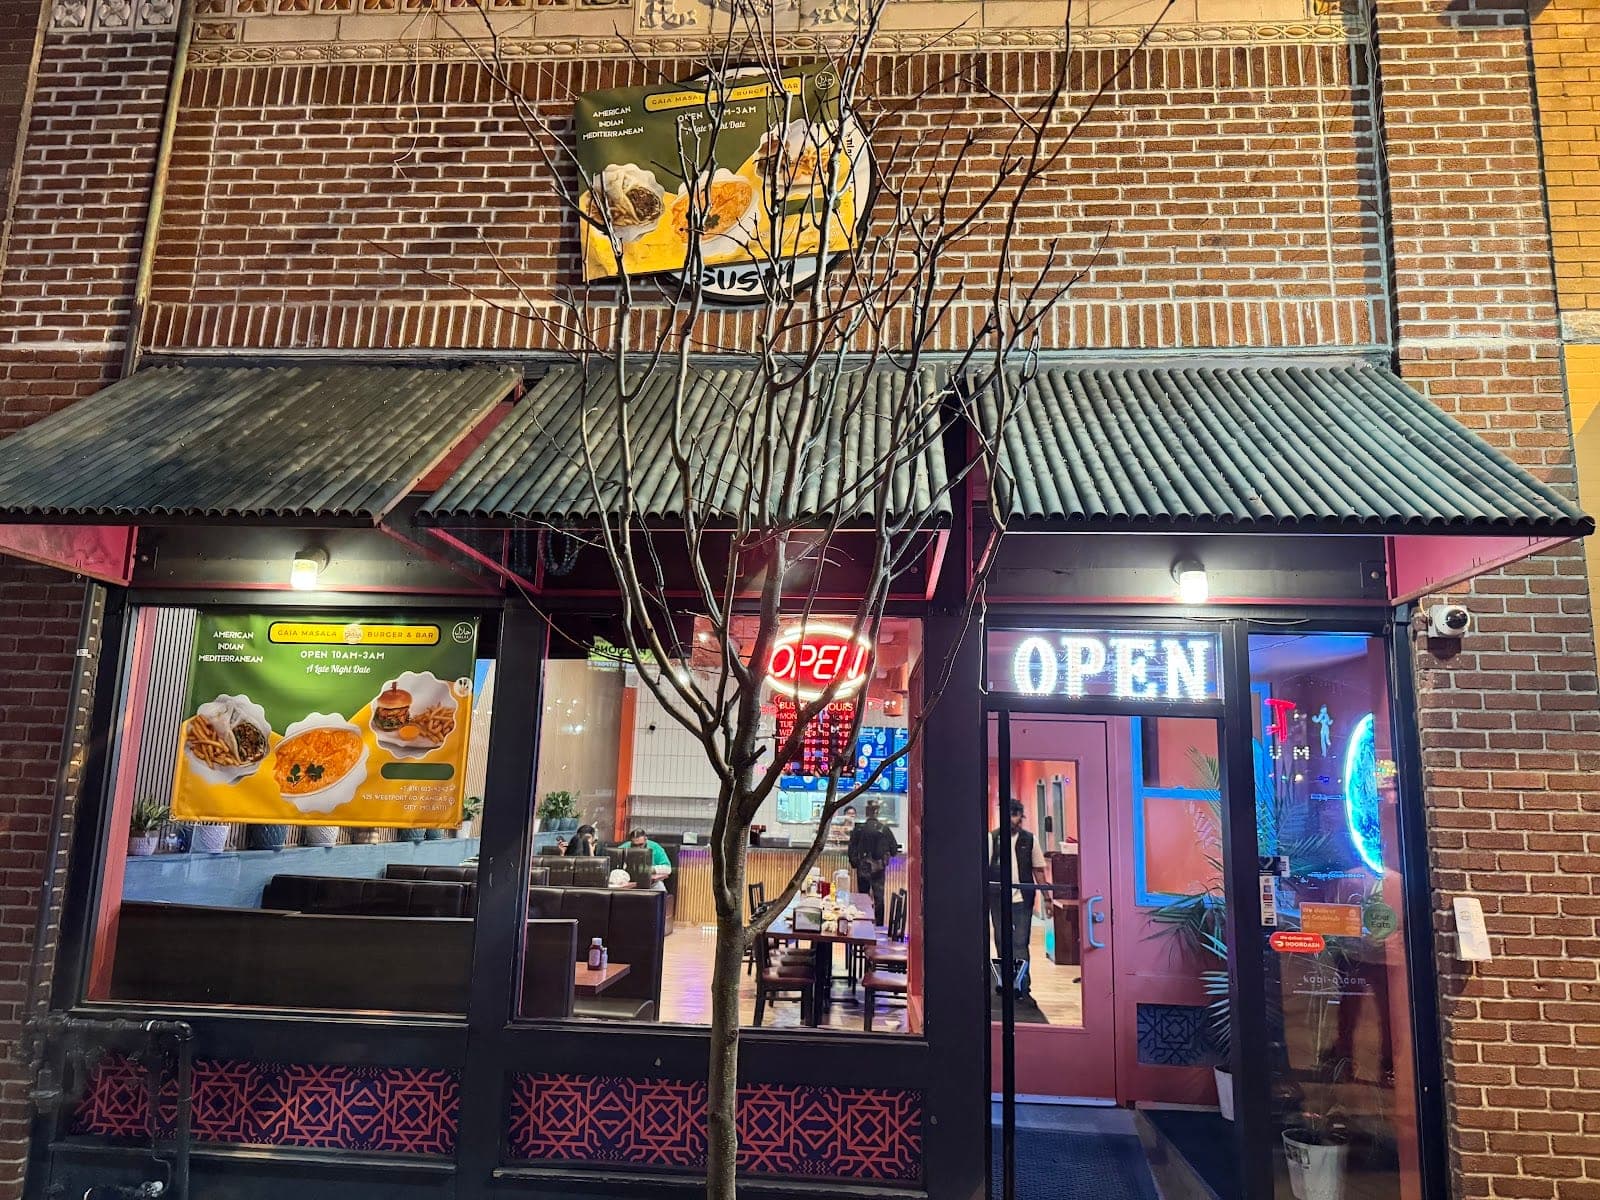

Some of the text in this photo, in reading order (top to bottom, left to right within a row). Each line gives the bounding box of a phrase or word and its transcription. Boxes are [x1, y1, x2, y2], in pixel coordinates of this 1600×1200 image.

[592, 106, 631, 118] AMERICAN
[598, 119, 624, 128] INDIAN
[729, 120, 746, 129] Date
[582, 126, 644, 140] MEDITERRANEAN
[213, 631, 254, 639] AMERICAN
[302, 630, 337, 638] MASALA
[367, 631, 403, 639] BURGER
[217, 643, 244, 651] INDIAN
[198, 654, 264, 663] MEDITERRANEAN
[300, 650, 385, 660] OPEN 10AM-3AM
[768, 644, 865, 680] OPEN
[306, 664, 371, 675] A Late Night Date
[1014, 636, 1209, 699] OPEN
[1371, 920, 1391, 928] Eats
